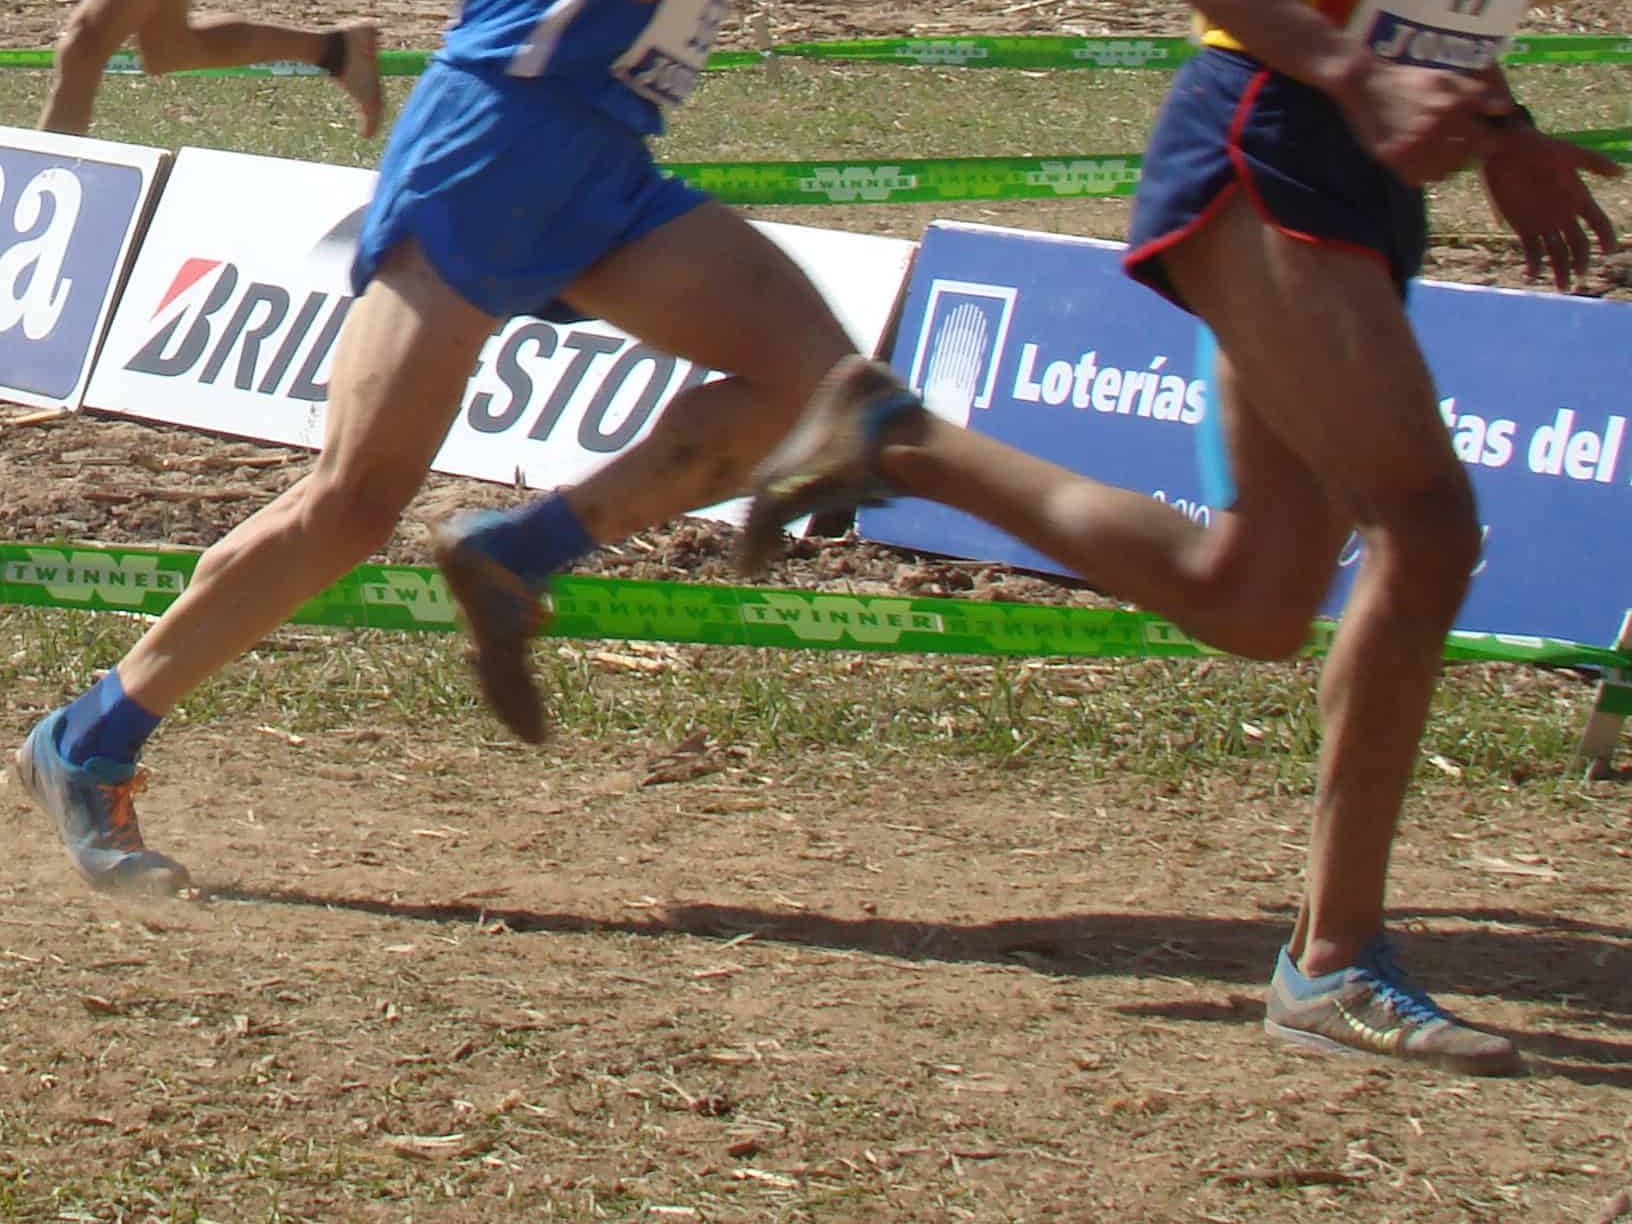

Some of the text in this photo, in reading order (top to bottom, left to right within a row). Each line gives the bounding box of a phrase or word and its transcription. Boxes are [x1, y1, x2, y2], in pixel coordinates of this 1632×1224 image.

[1011, 342, 1208, 425] Loterías
[1527, 407, 1626, 483] del
[13, 564, 176, 591] TWINNER
[753, 606, 934, 630] TWINNER
